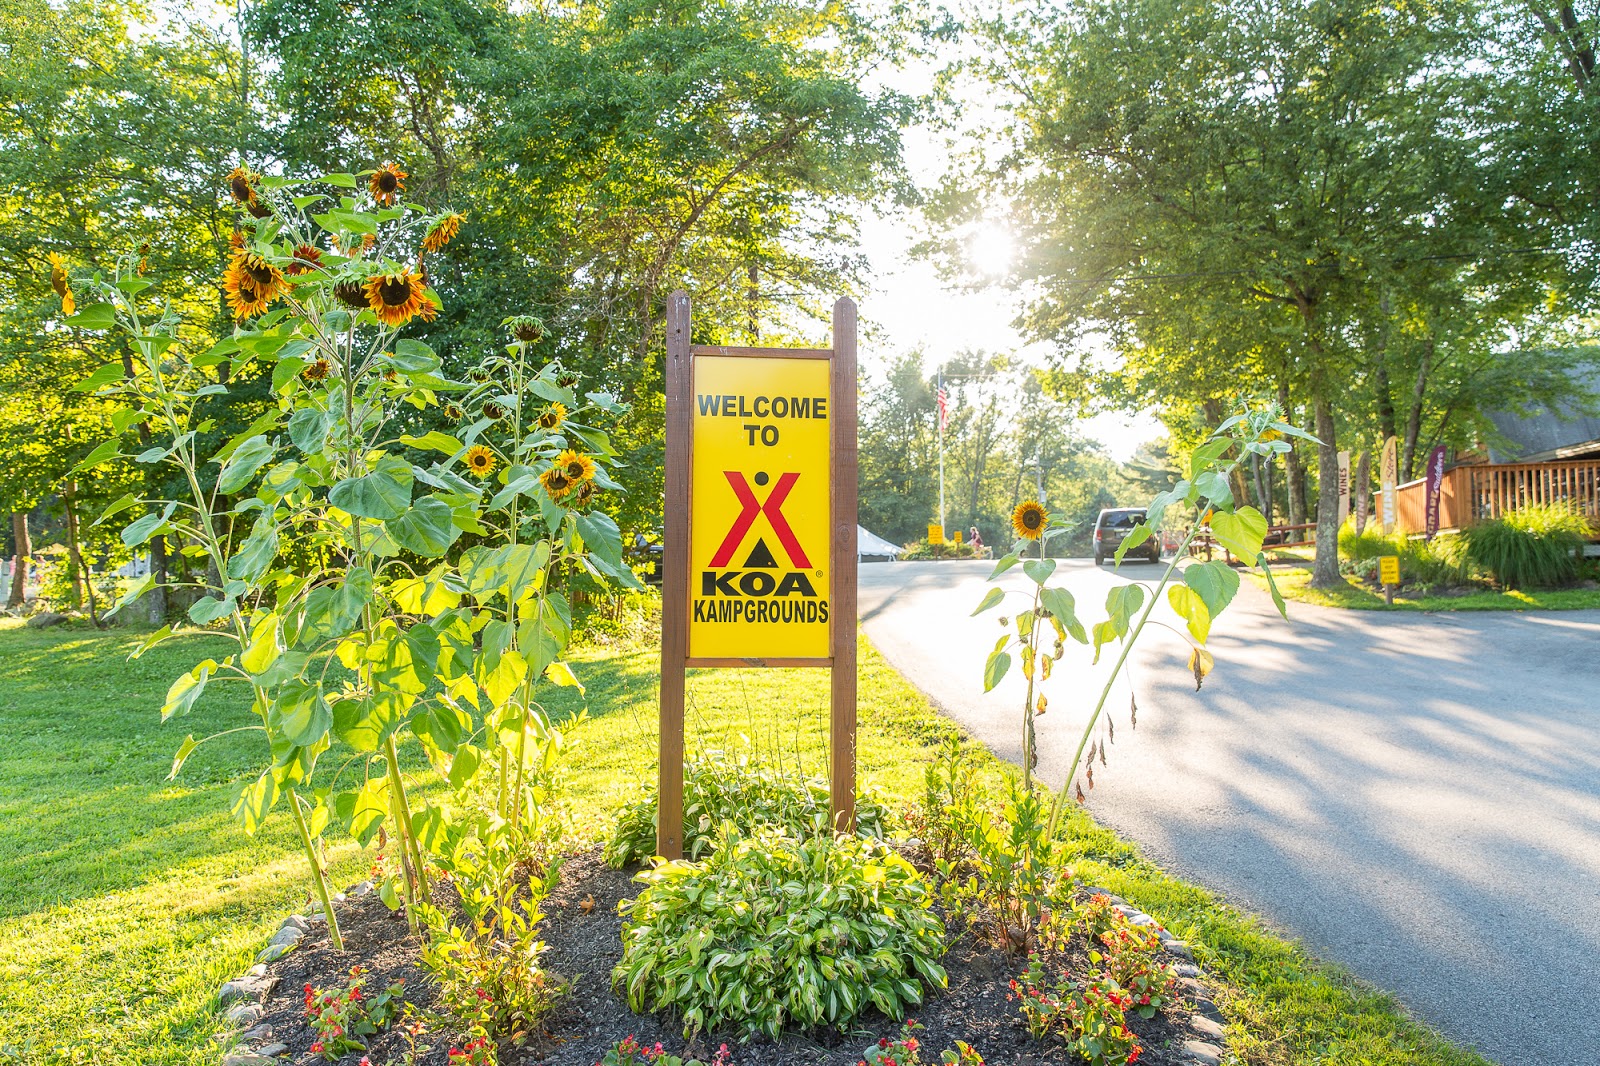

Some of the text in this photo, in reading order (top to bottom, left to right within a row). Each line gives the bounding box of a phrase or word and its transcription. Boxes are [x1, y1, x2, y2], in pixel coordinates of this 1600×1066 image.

[698, 395, 827, 419] WELCOME
[744, 425, 779, 446] TO
[1357, 494, 1365, 529] WINE
[1383, 482, 1394, 525] WINE
[1428, 491, 1438, 534] GRAPE
[702, 571, 818, 596] KOA
[694, 600, 828, 623] KAMPGROUNDS
